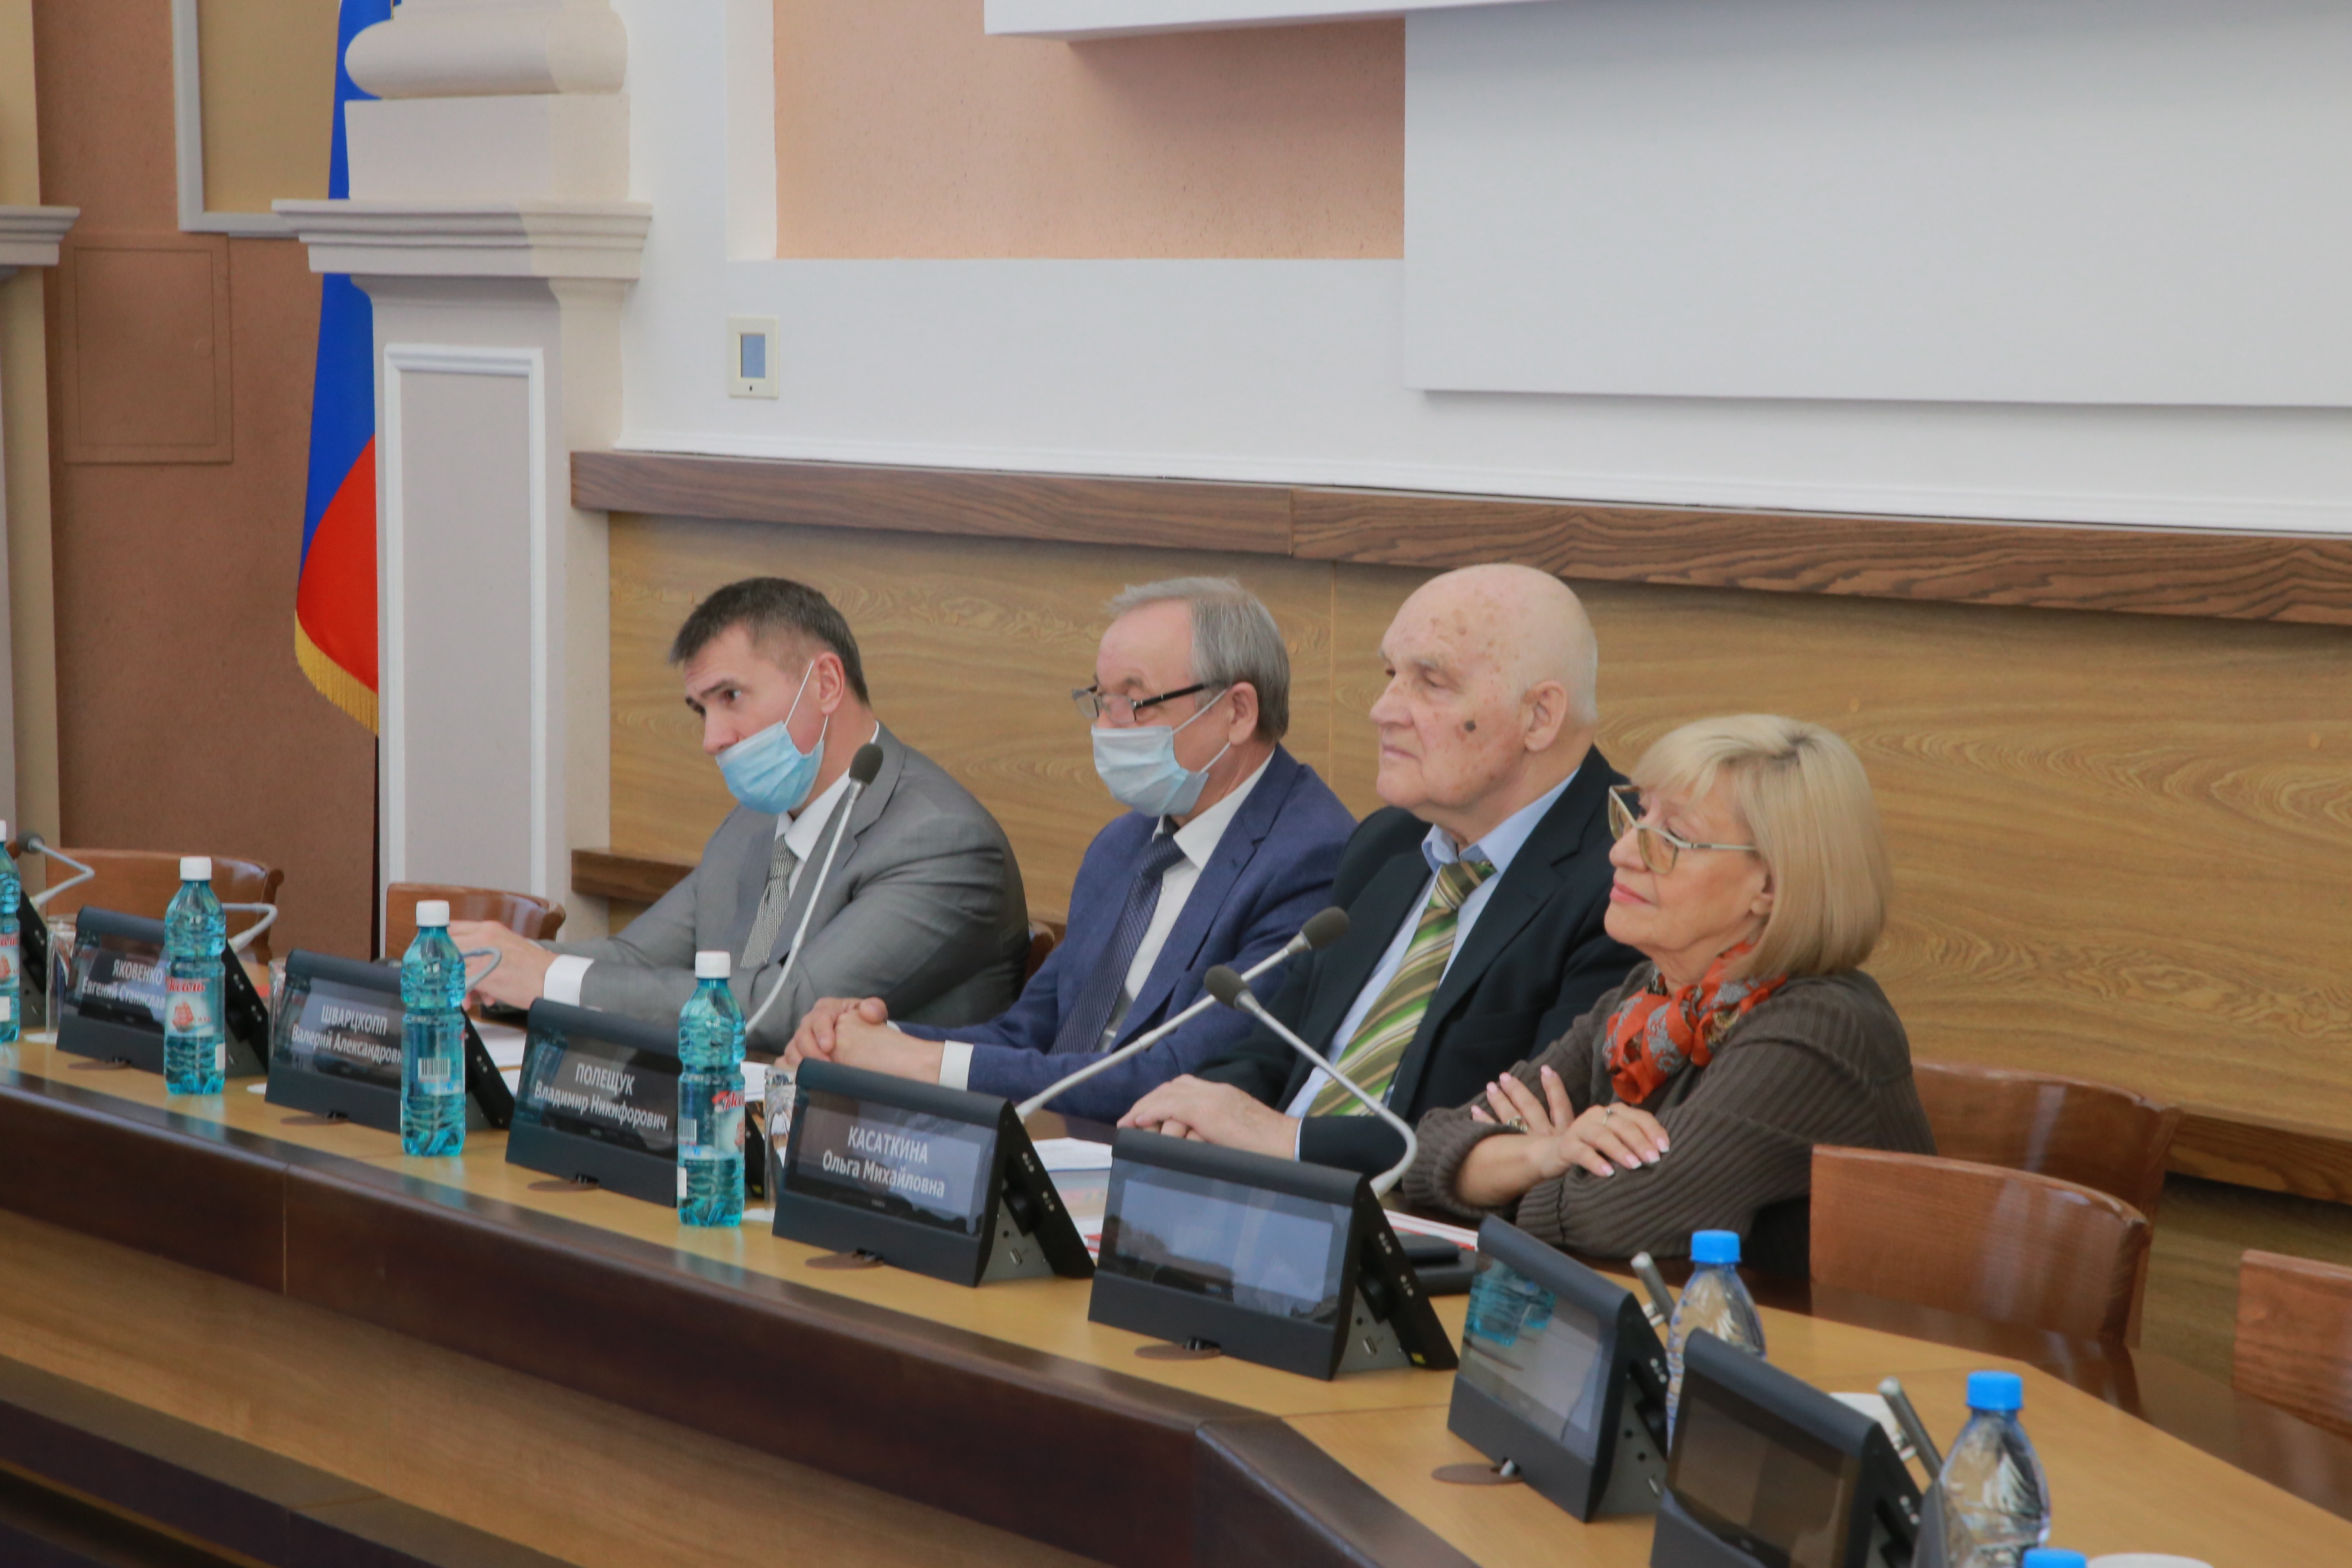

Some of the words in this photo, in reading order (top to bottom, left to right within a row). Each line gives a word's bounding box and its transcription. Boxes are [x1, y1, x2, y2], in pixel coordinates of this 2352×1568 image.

[81, 976, 119, 999] Евгений
[112, 959, 162, 986] ЯКОВЕНКО
[320, 1005, 388, 1036] ШВАРЦКОПП
[291, 1023, 333, 1051] Валерий
[574, 1062, 635, 1096] ПОЛЕЩУК
[534, 1079, 589, 1116] Владимир
[589, 1093, 668, 1132] Никифорович
[847, 1125, 928, 1165] КАСАТКИНА
[822, 1148, 861, 1179] Ольга
[862, 1159, 946, 1199] Михайловна
